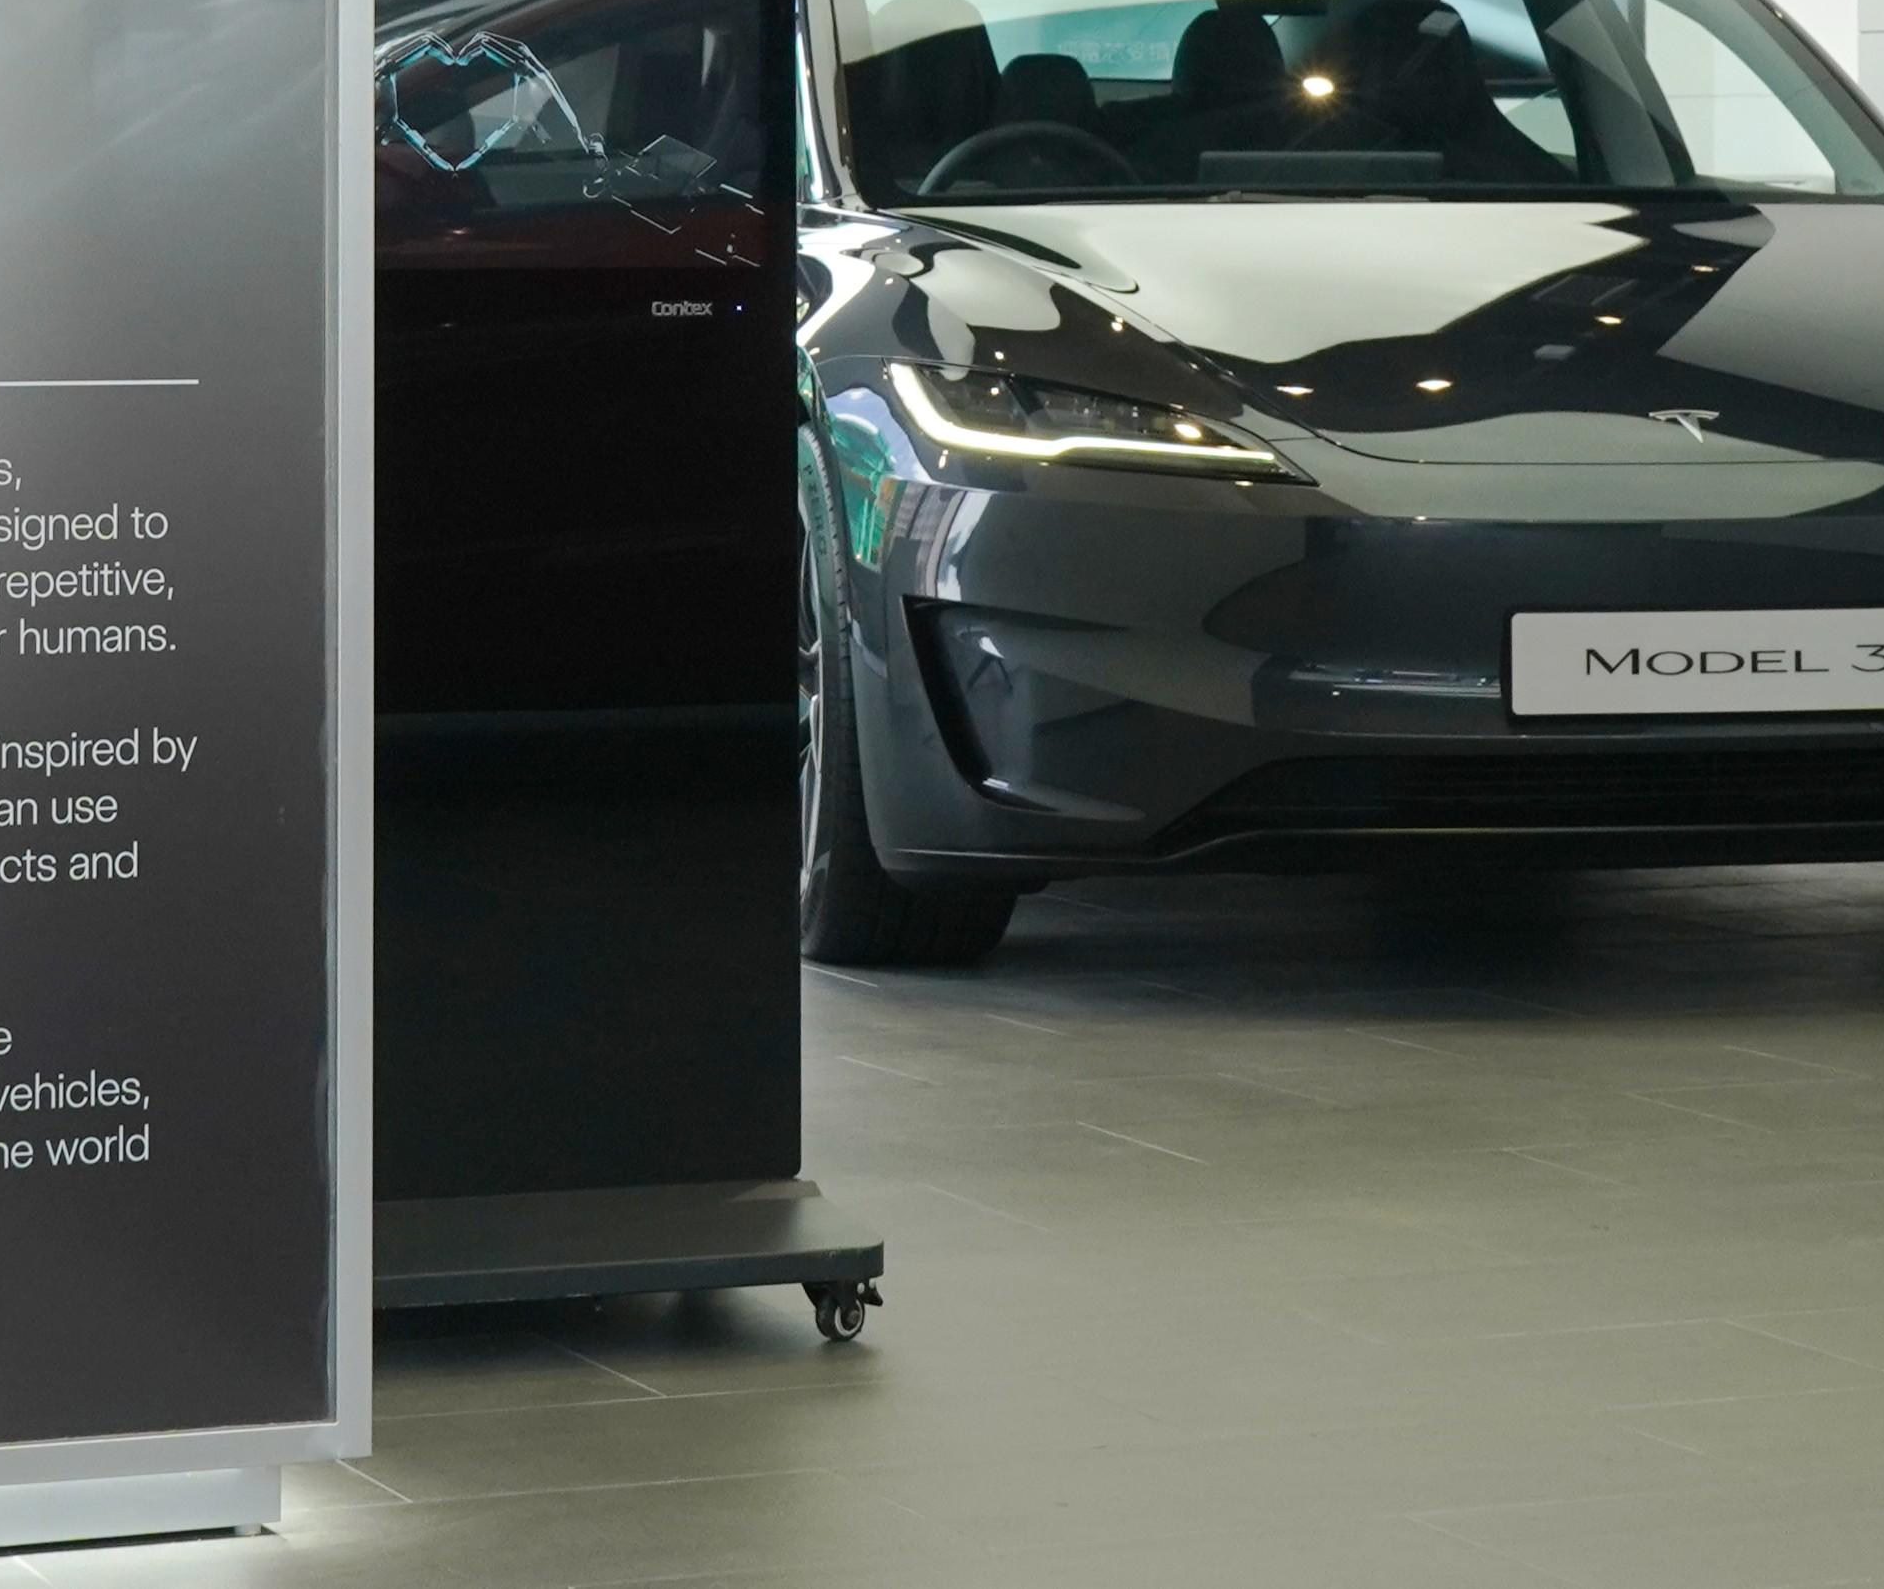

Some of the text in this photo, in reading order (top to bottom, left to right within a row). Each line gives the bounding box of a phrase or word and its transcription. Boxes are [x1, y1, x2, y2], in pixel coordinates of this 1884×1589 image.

[130, 506, 169, 540] to
[19, 617, 177, 655] humans.
[1585, 647, 1829, 676] MODEL
[152, 726, 198, 772] by
[51, 795, 118, 825] use
[68, 840, 139, 881] and
[45, 1123, 150, 1166] world
